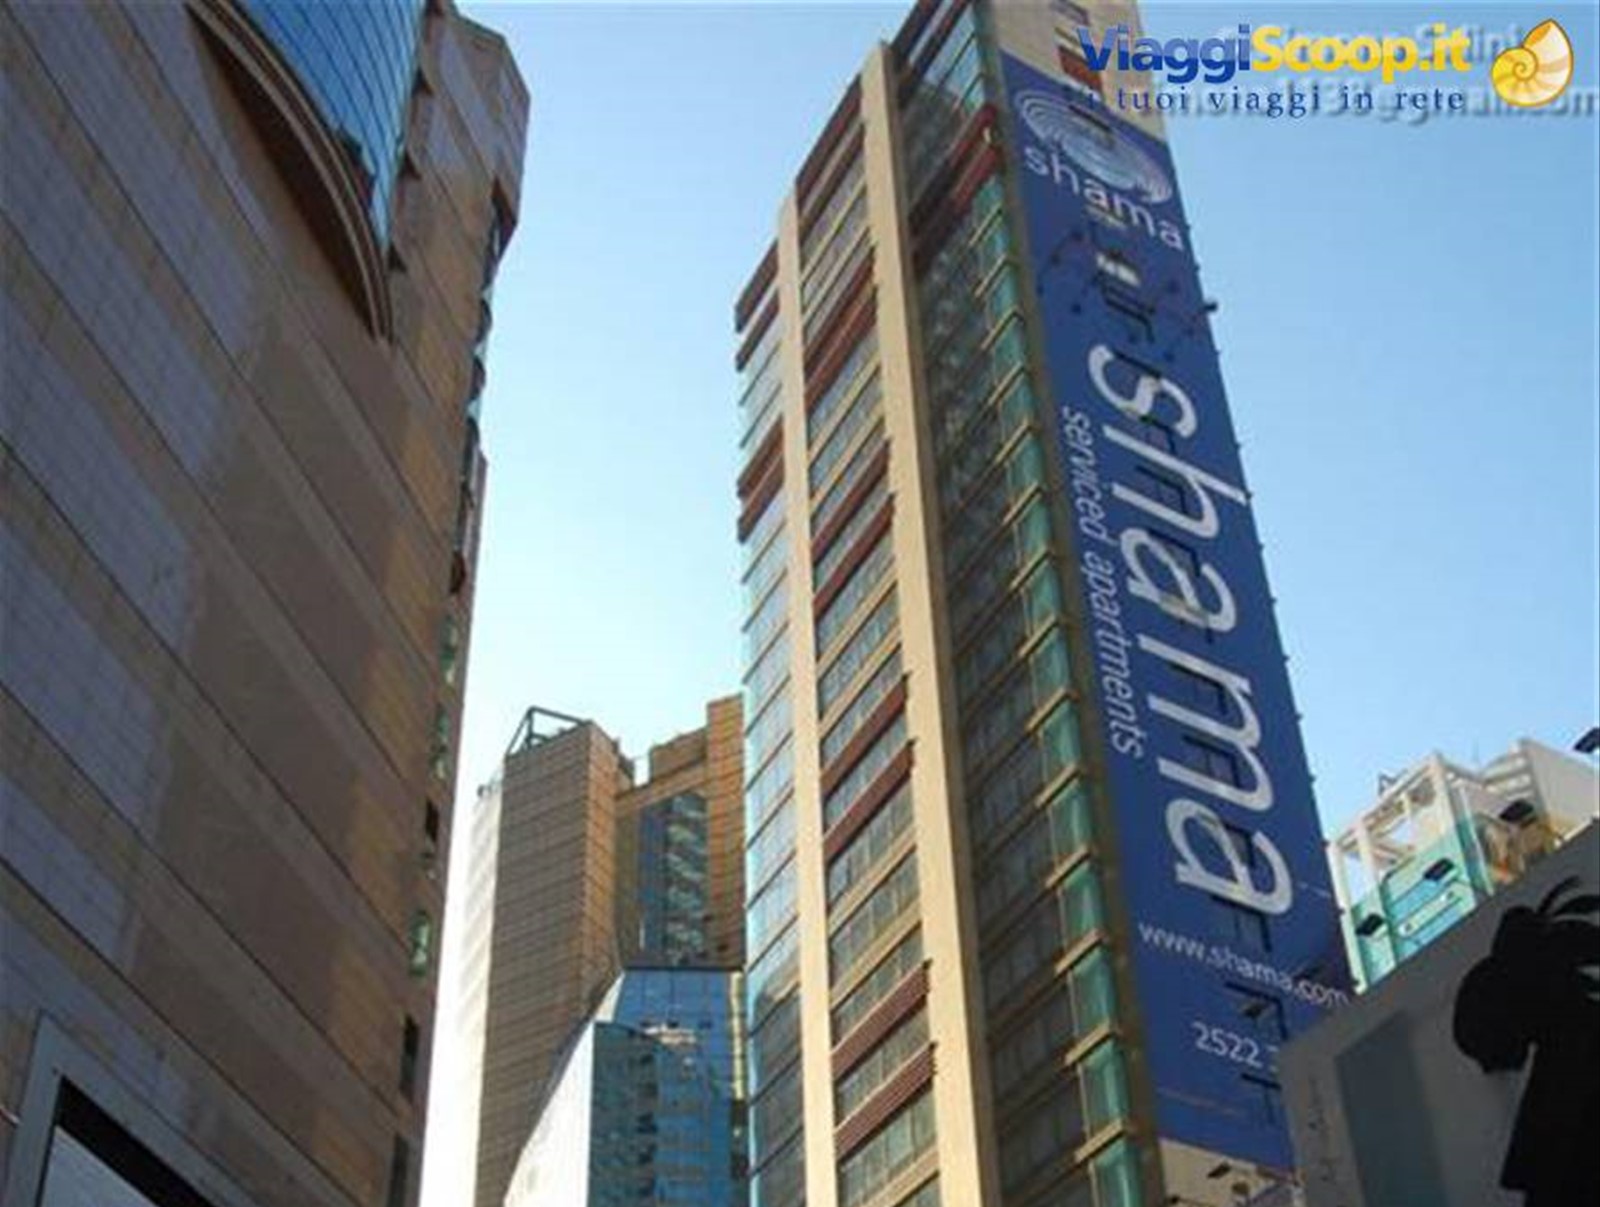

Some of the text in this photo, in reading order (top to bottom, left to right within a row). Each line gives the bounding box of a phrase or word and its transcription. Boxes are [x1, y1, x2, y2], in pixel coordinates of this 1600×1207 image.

[1024, 147, 1184, 251] shama
[1062, 406, 1148, 758] serviced apartments
[1088, 345, 1294, 914] shama
[1138, 921, 1350, 1007] www.shama.com
